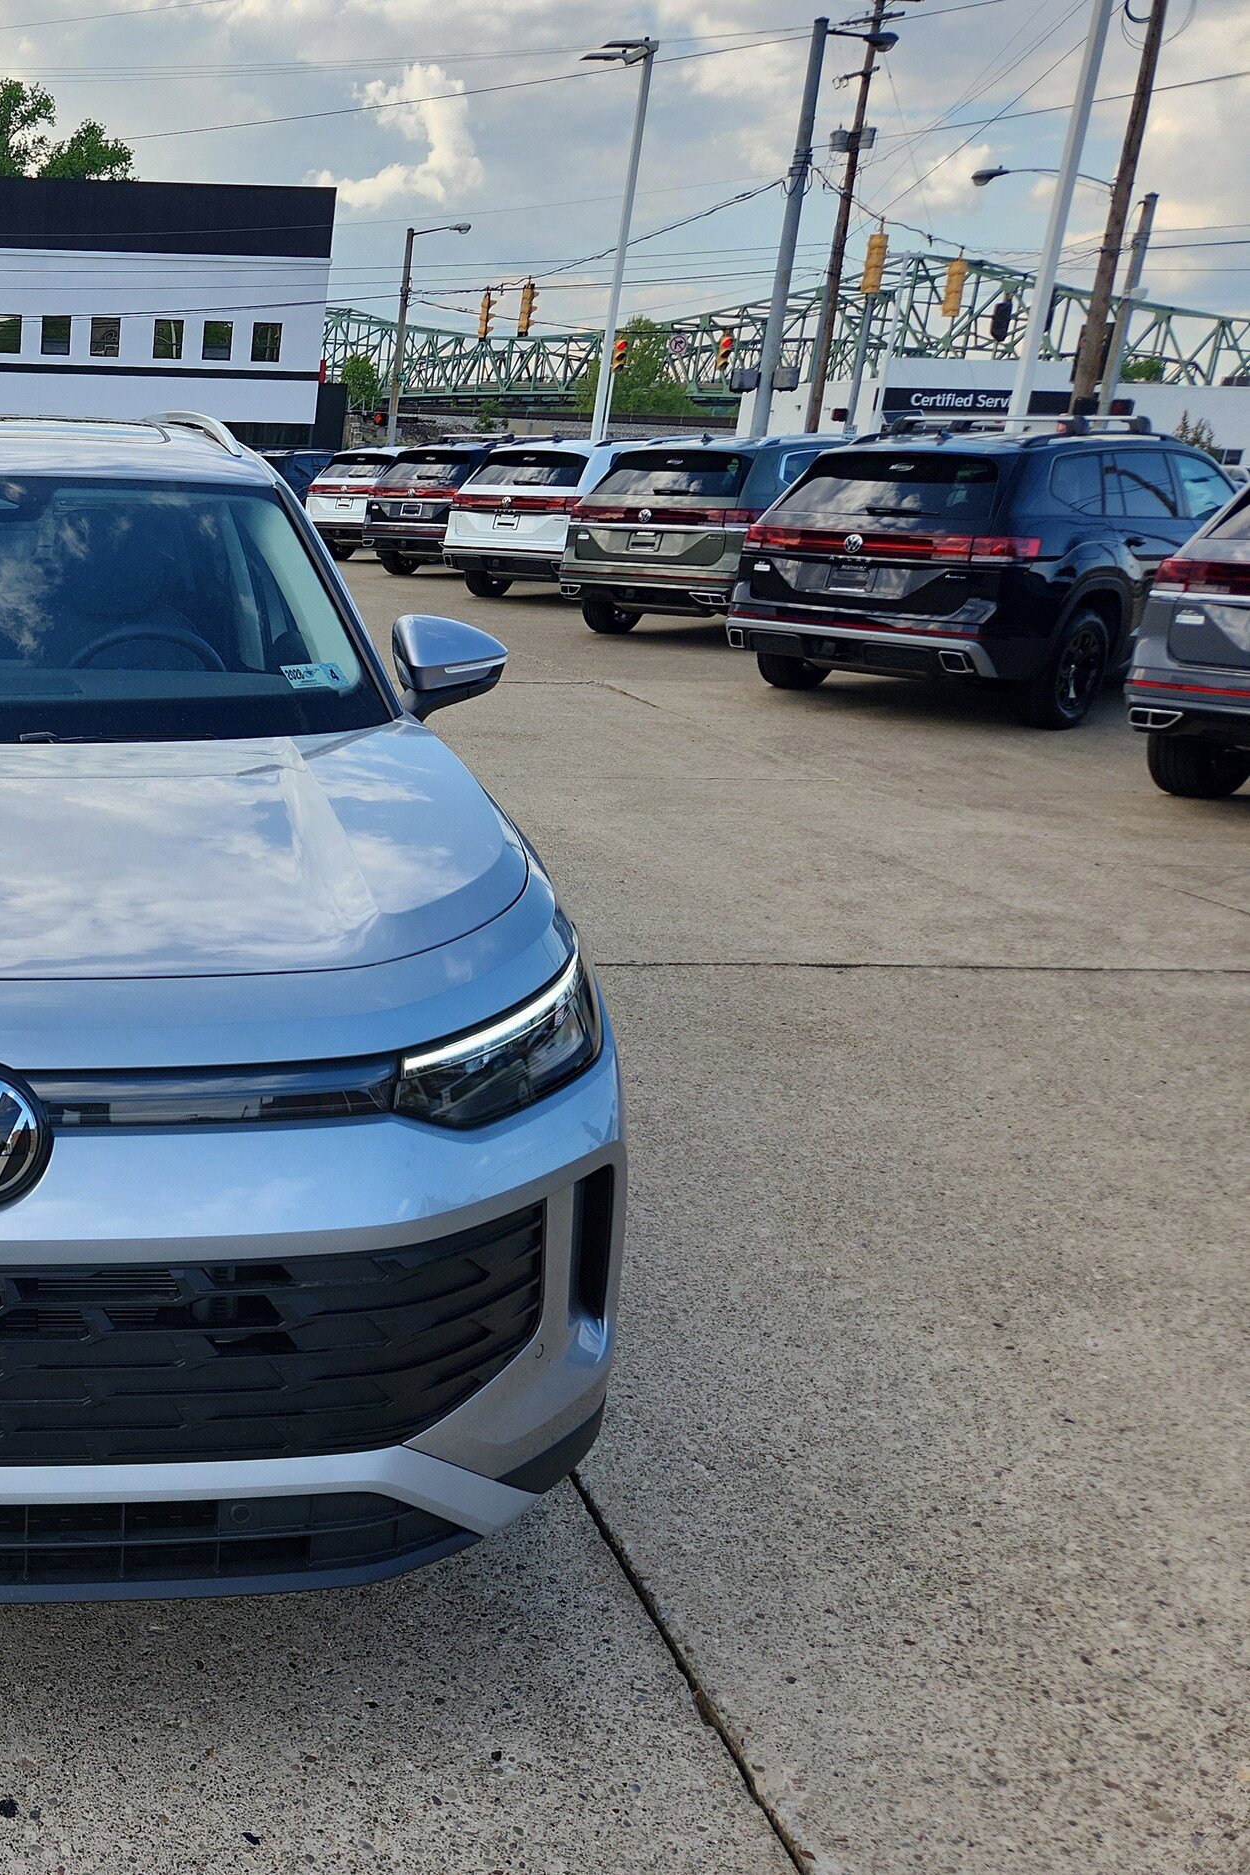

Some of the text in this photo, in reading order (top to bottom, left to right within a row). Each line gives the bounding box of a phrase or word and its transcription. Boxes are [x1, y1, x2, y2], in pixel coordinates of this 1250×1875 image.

[910, 392, 1013, 408] Certified Servi
[329, 668, 340, 681] 4
